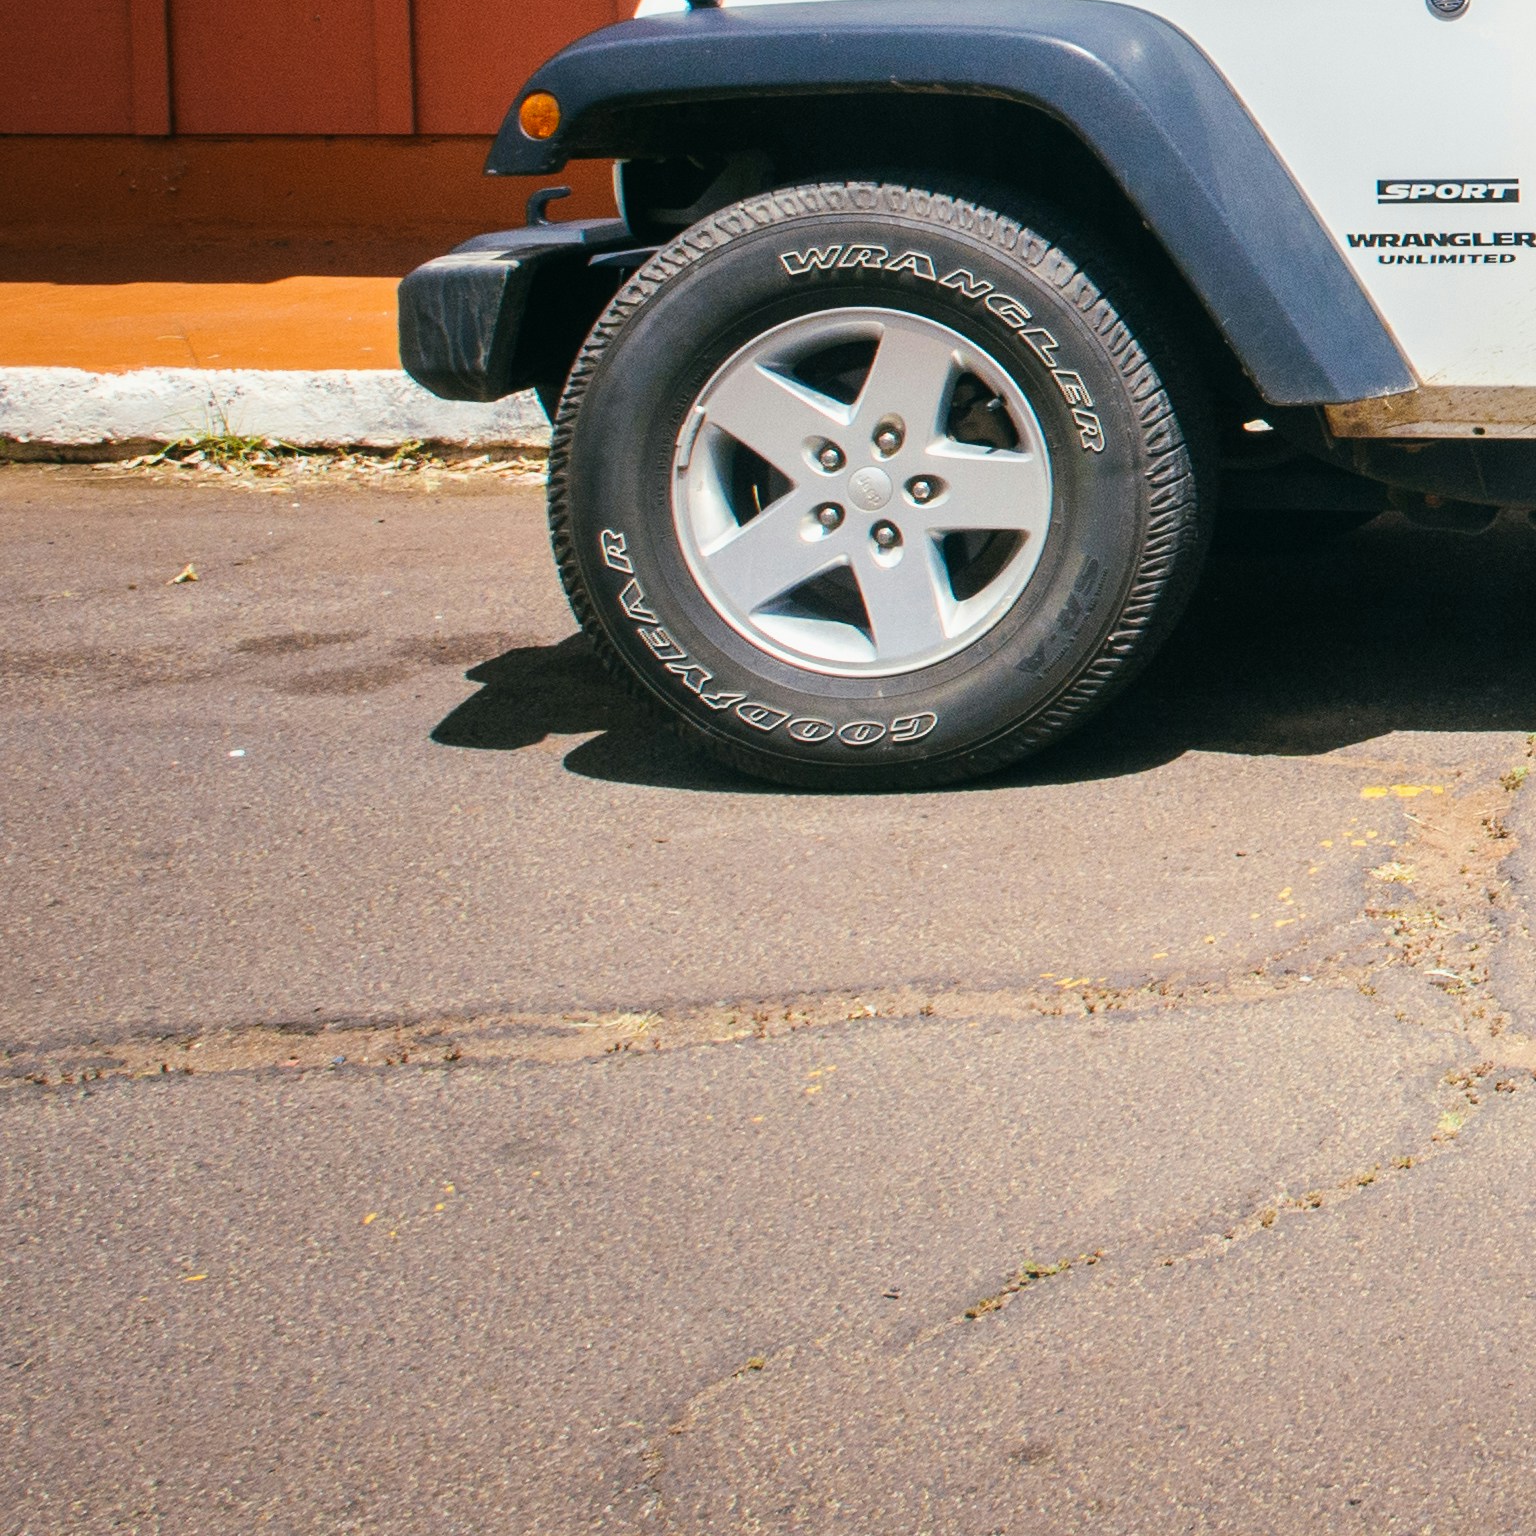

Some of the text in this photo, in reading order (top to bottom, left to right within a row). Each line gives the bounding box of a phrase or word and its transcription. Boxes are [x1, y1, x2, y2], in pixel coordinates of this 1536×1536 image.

[1378, 183, 1520, 200] SPORT
[1378, 253, 1517, 265] UNLIMITED
[781, 245, 1104, 454] WRANGLER
[601, 529, 938, 745] GOODYEAR
